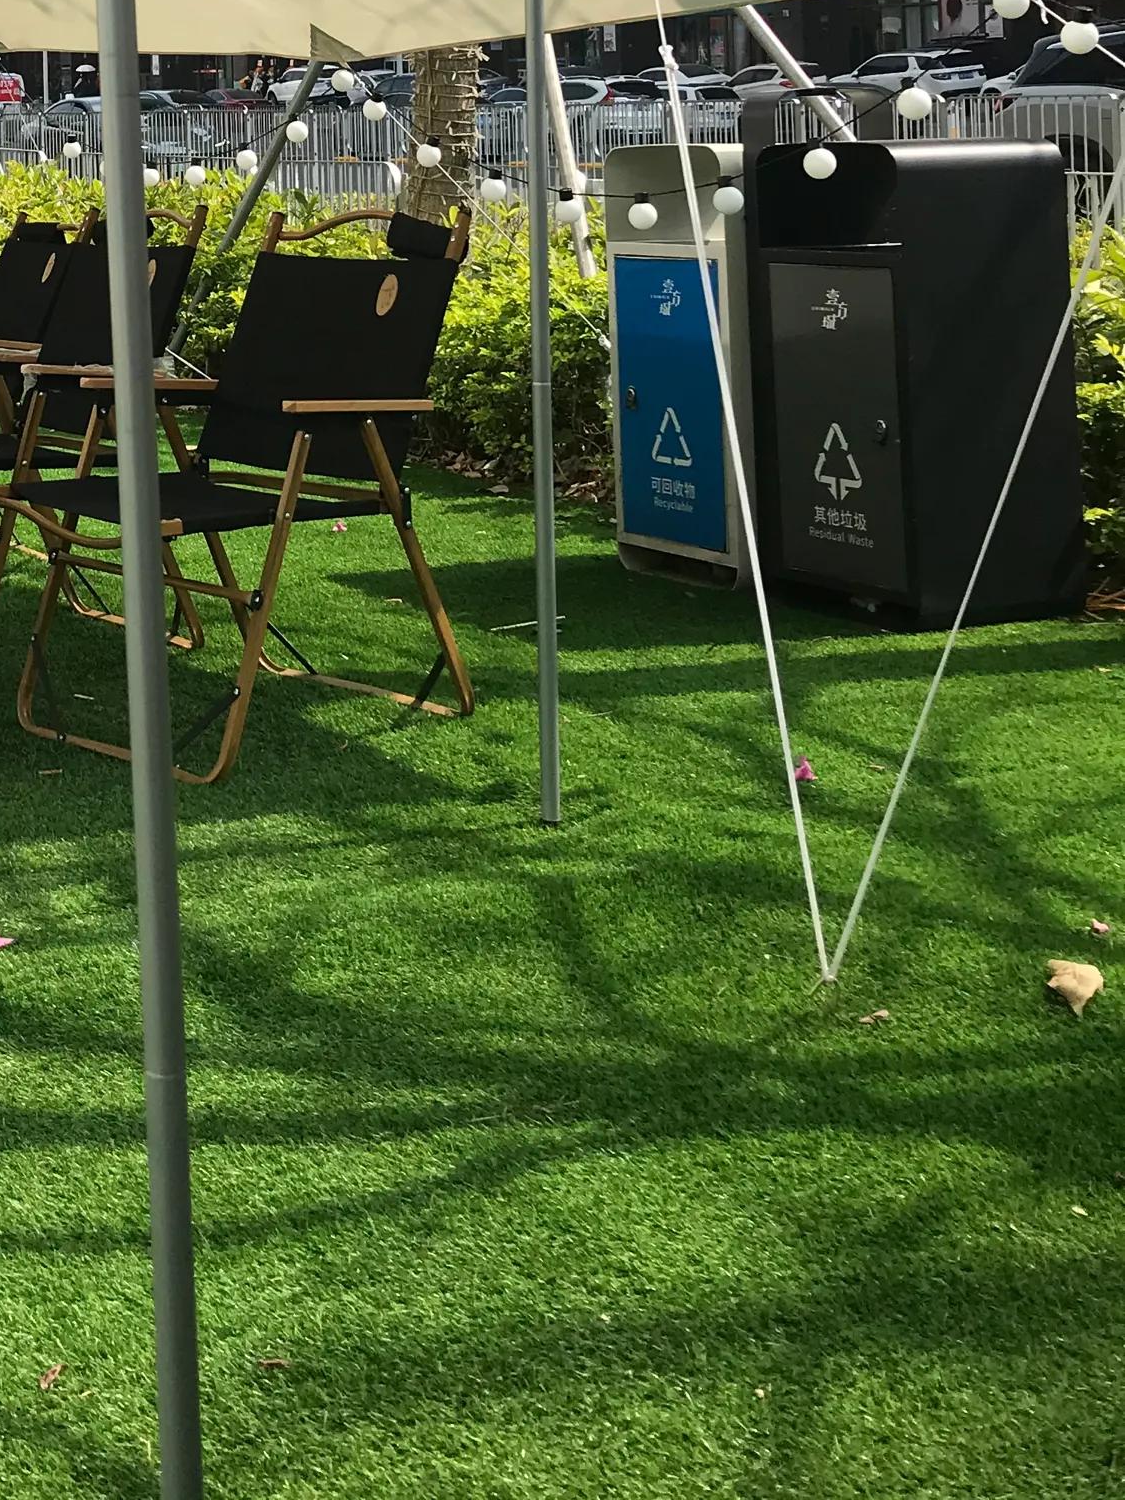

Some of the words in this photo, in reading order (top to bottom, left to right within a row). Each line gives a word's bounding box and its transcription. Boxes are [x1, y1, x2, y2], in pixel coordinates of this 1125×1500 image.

[650, 476, 696, 500] 可回收物
[814, 505, 868, 531] 其他垃圾
[809, 526, 846, 542] Residual
[848, 533, 874, 548] Waste
